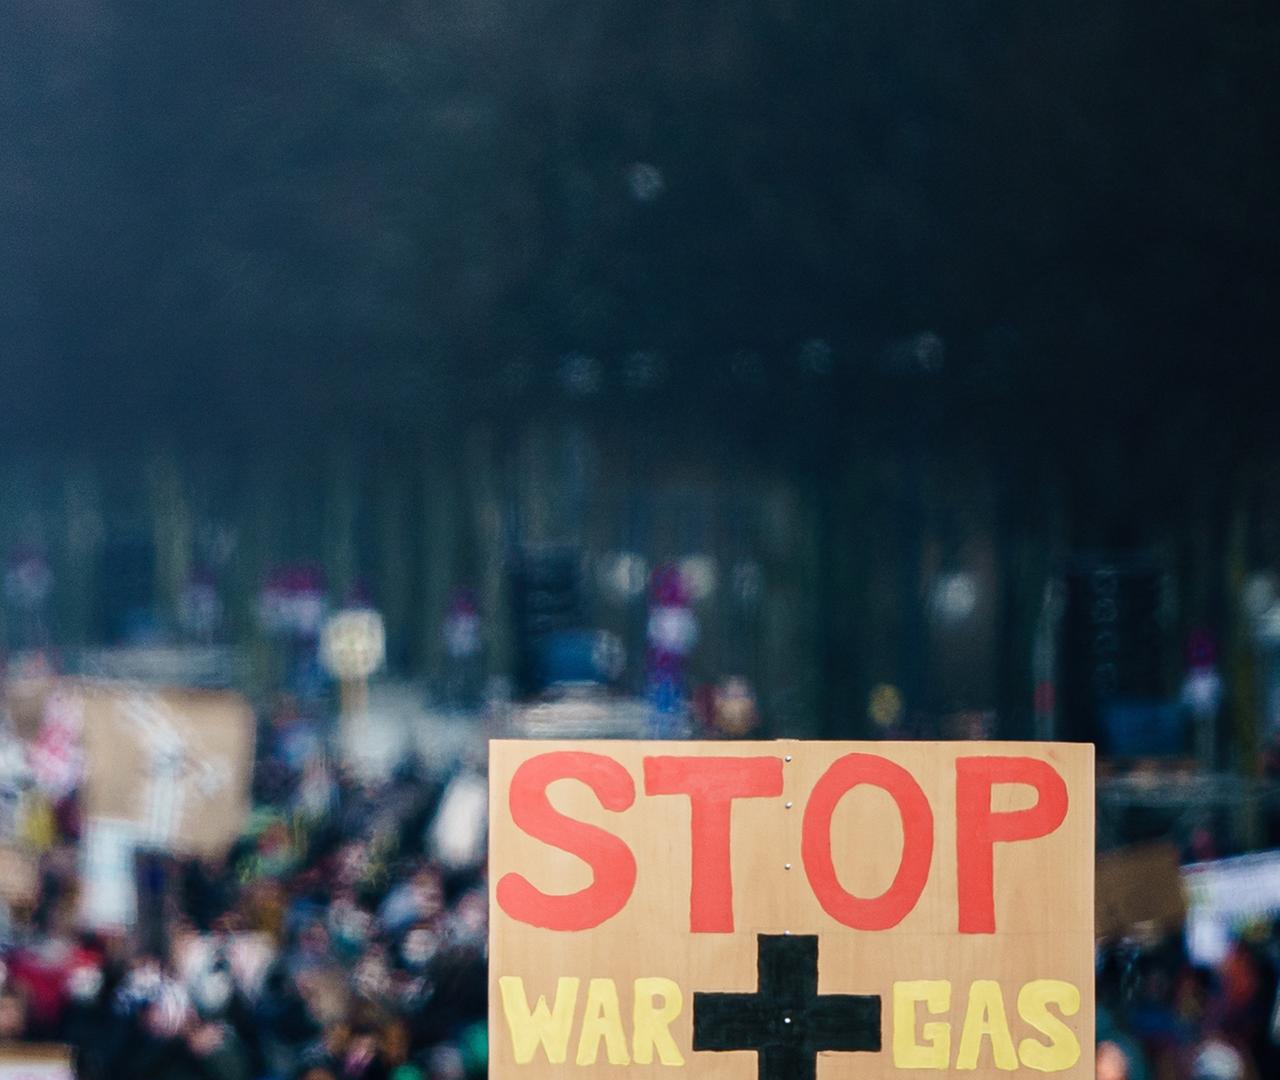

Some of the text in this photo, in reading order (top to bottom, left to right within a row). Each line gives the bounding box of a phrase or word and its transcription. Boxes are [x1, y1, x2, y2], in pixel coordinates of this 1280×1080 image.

[496, 751, 1069, 933] STOP
[499, 976, 1080, 1072] WAR GAS
